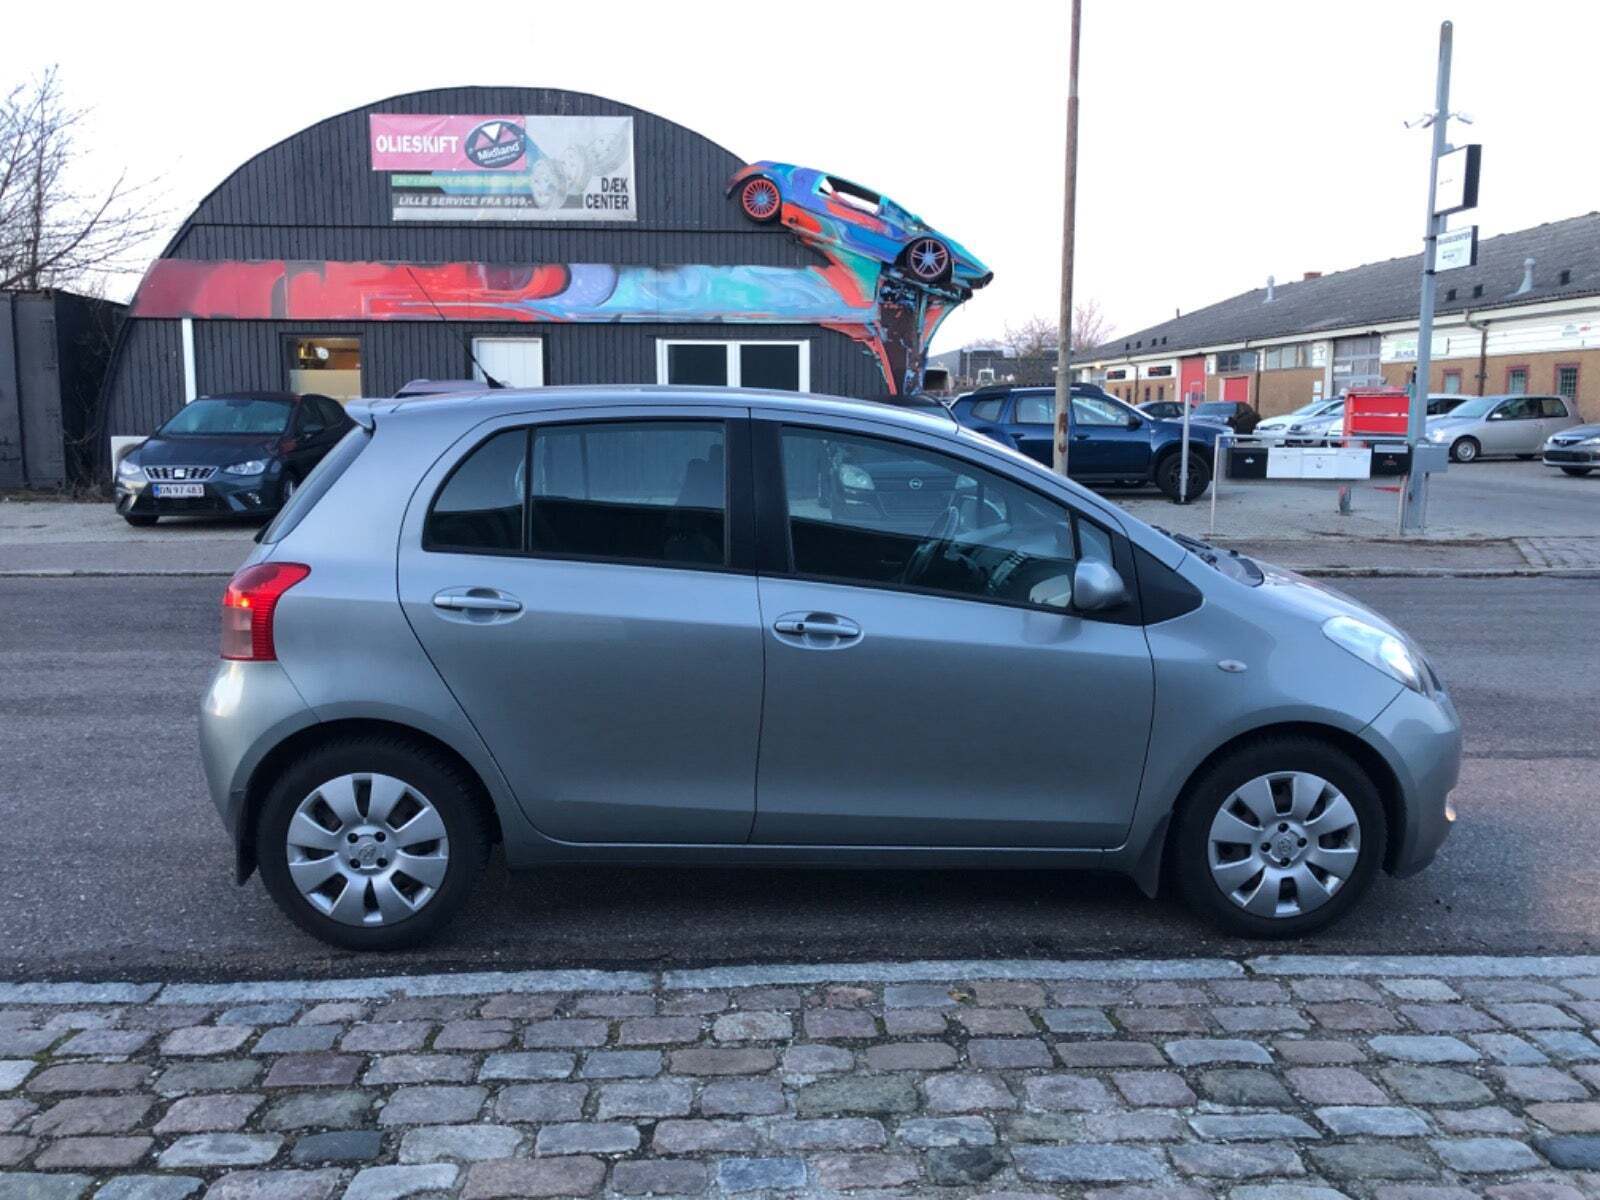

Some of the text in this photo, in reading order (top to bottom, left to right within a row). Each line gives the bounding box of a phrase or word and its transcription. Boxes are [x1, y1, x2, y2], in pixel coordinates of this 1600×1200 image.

[375, 134, 459, 154] OLIESKIFT
[477, 141, 520, 160] Midland
[601, 176, 628, 193] DÆK
[399, 196, 429, 206] LILLE
[431, 196, 478, 206] SERVICE
[585, 193, 629, 210] CENTER
